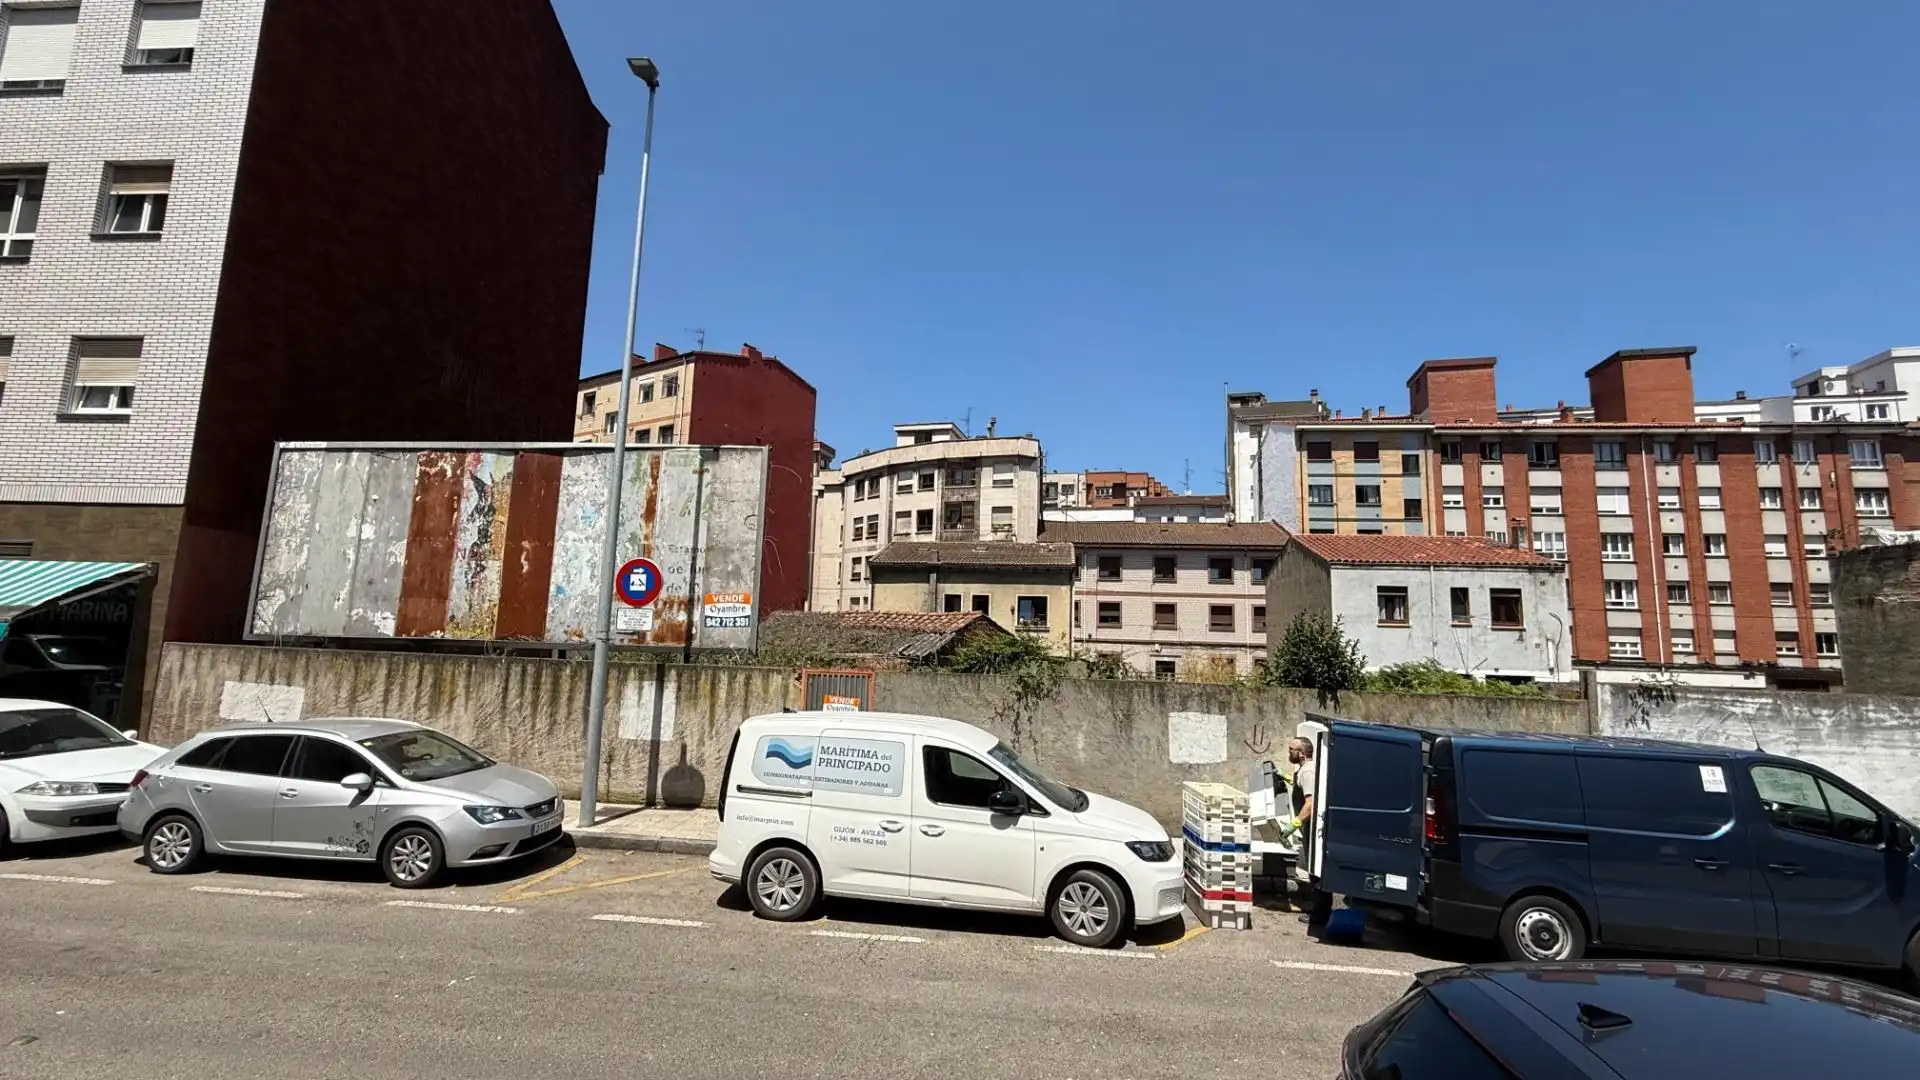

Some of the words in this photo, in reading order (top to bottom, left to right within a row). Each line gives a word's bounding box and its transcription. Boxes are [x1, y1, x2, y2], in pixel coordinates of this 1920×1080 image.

[712, 594, 745, 602] VENDE
[709, 605, 746, 613] Oyambre
[706, 618, 721, 627] 942
[722, 618, 734, 627] 712
[735, 618, 749, 627] 351
[820, 746, 879, 760] MARÍTIMA
[881, 753, 892, 761] del
[818, 758, 891, 773] PRINCIPADO
